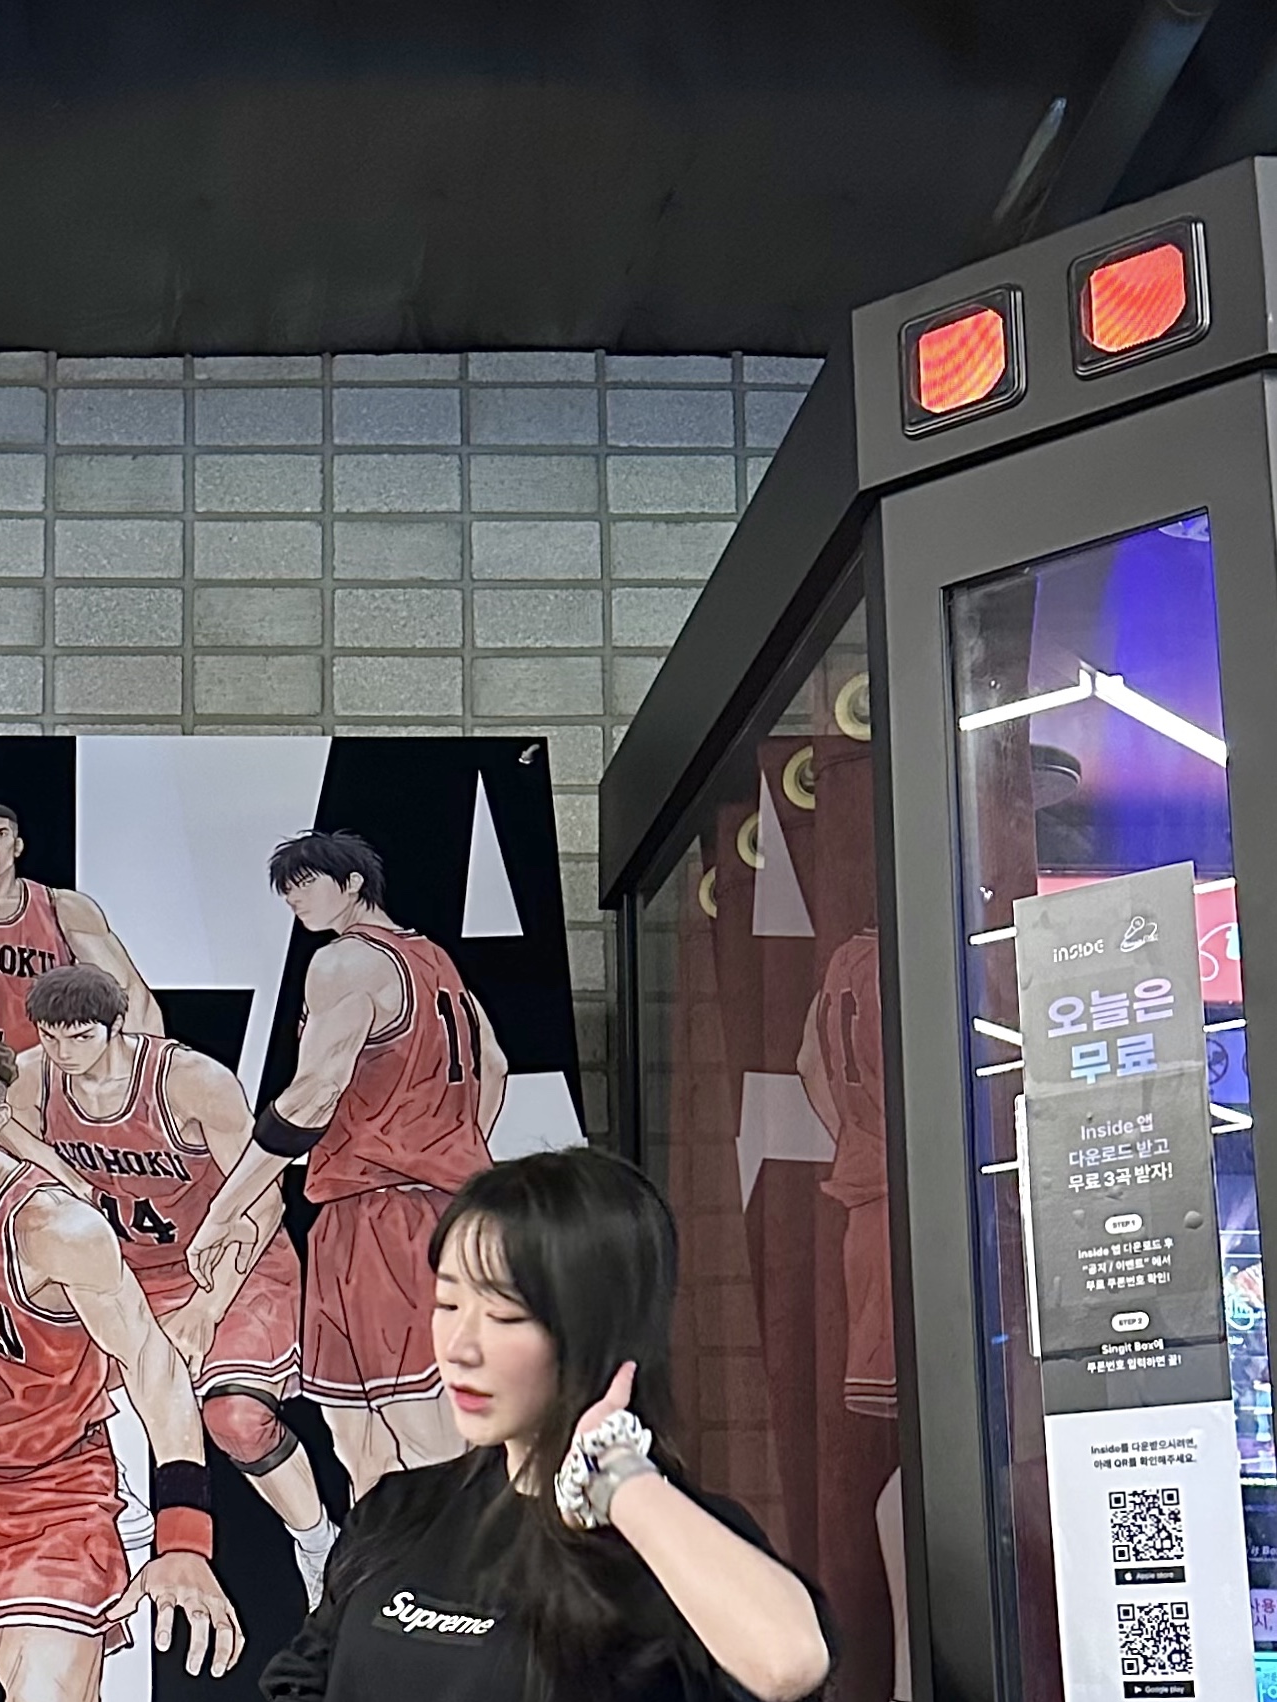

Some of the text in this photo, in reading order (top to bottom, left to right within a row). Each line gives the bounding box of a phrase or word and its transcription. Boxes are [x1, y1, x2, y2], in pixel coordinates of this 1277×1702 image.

[1048, 977, 1174, 1038] 오늘은
[1070, 1032, 1158, 1085] 무료
[1080, 1112, 1154, 1141] Inside 앱
[1068, 1137, 1170, 1168] 다운로드 받고
[1068, 1161, 1173, 1193] 무료 3곡 받자!
[97, 1191, 179, 1245] 14
[382, 1591, 495, 1635] Supreme
